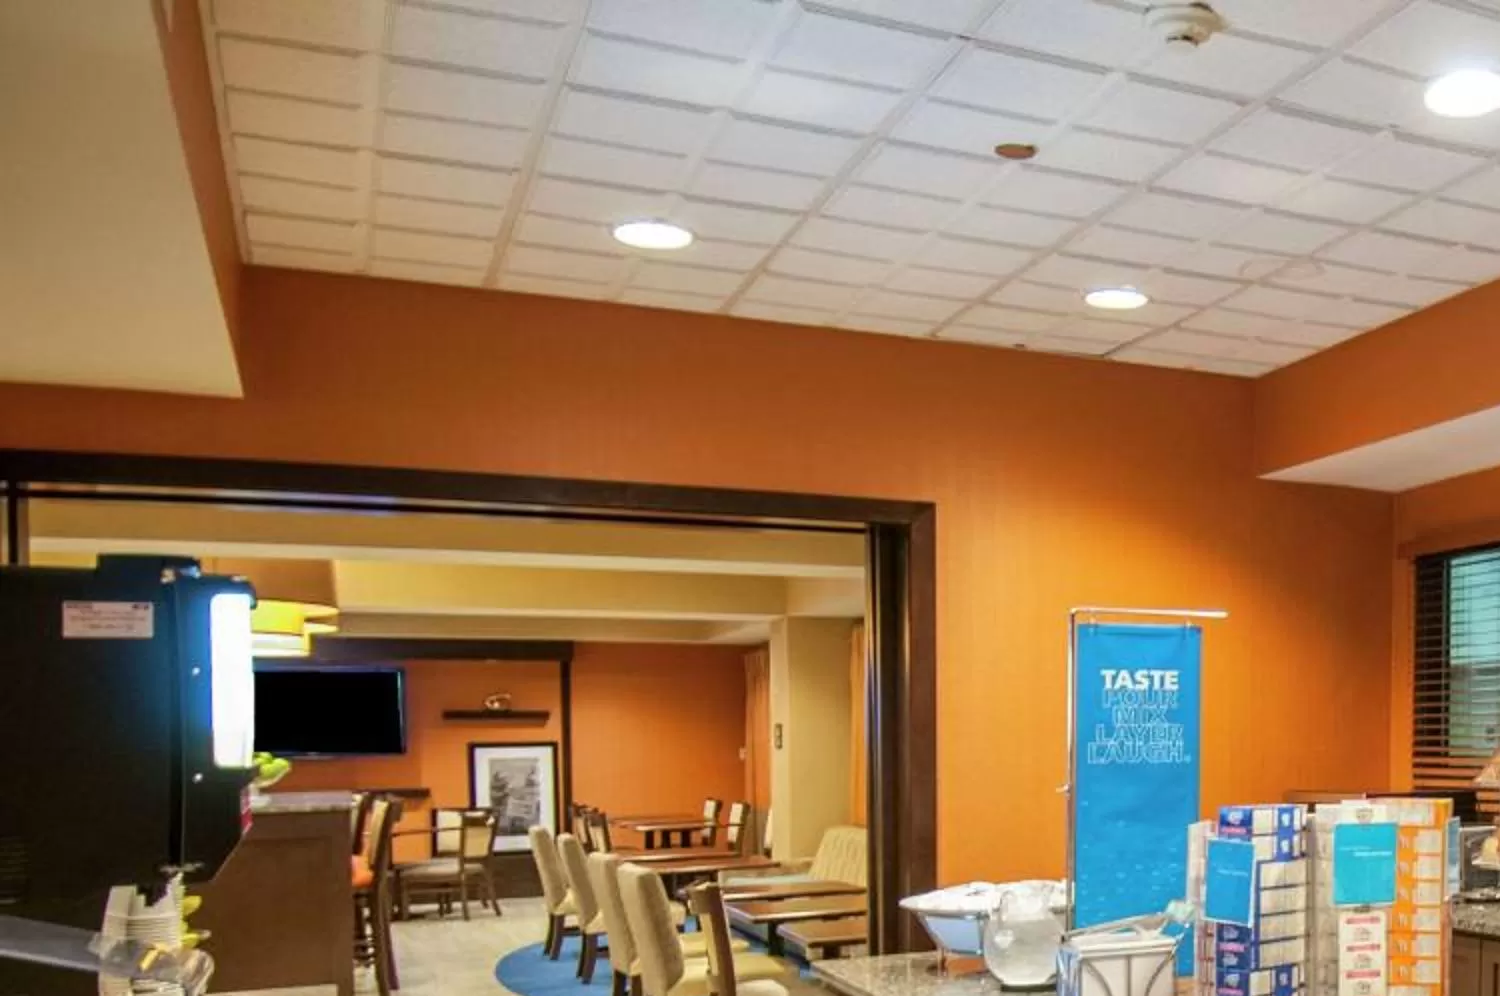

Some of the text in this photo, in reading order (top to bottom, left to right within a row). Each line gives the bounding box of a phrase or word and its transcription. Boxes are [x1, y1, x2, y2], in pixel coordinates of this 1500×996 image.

[1100, 669, 1179, 691] TASTE
[1095, 723, 1185, 744] LAYER
[1087, 741, 1193, 764] LAUGH.
